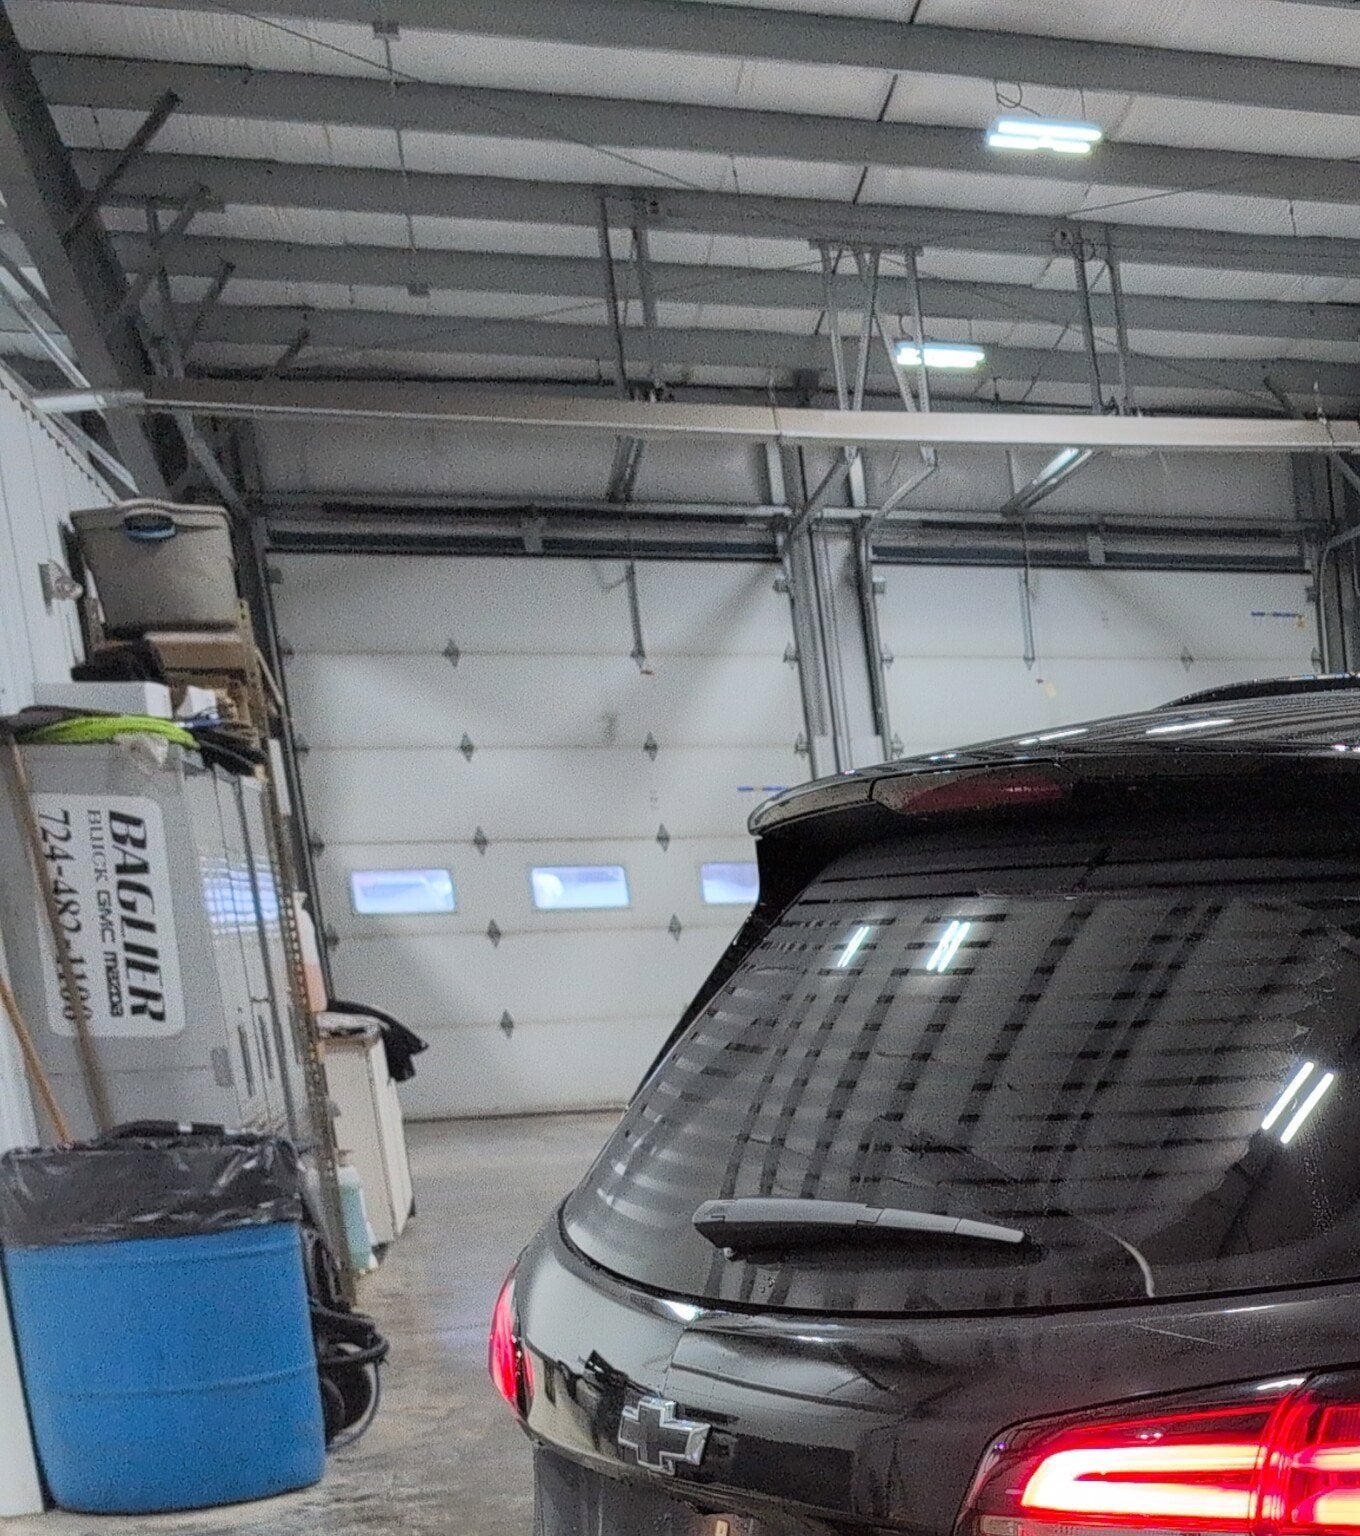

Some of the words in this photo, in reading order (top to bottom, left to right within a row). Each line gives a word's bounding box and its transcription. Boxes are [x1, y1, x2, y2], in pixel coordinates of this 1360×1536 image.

[86, 808, 109, 883] BUICK
[96, 889, 117, 944] GMC
[108, 809, 167, 1022] BAGLIER
[102, 950, 125, 1018] mazda
